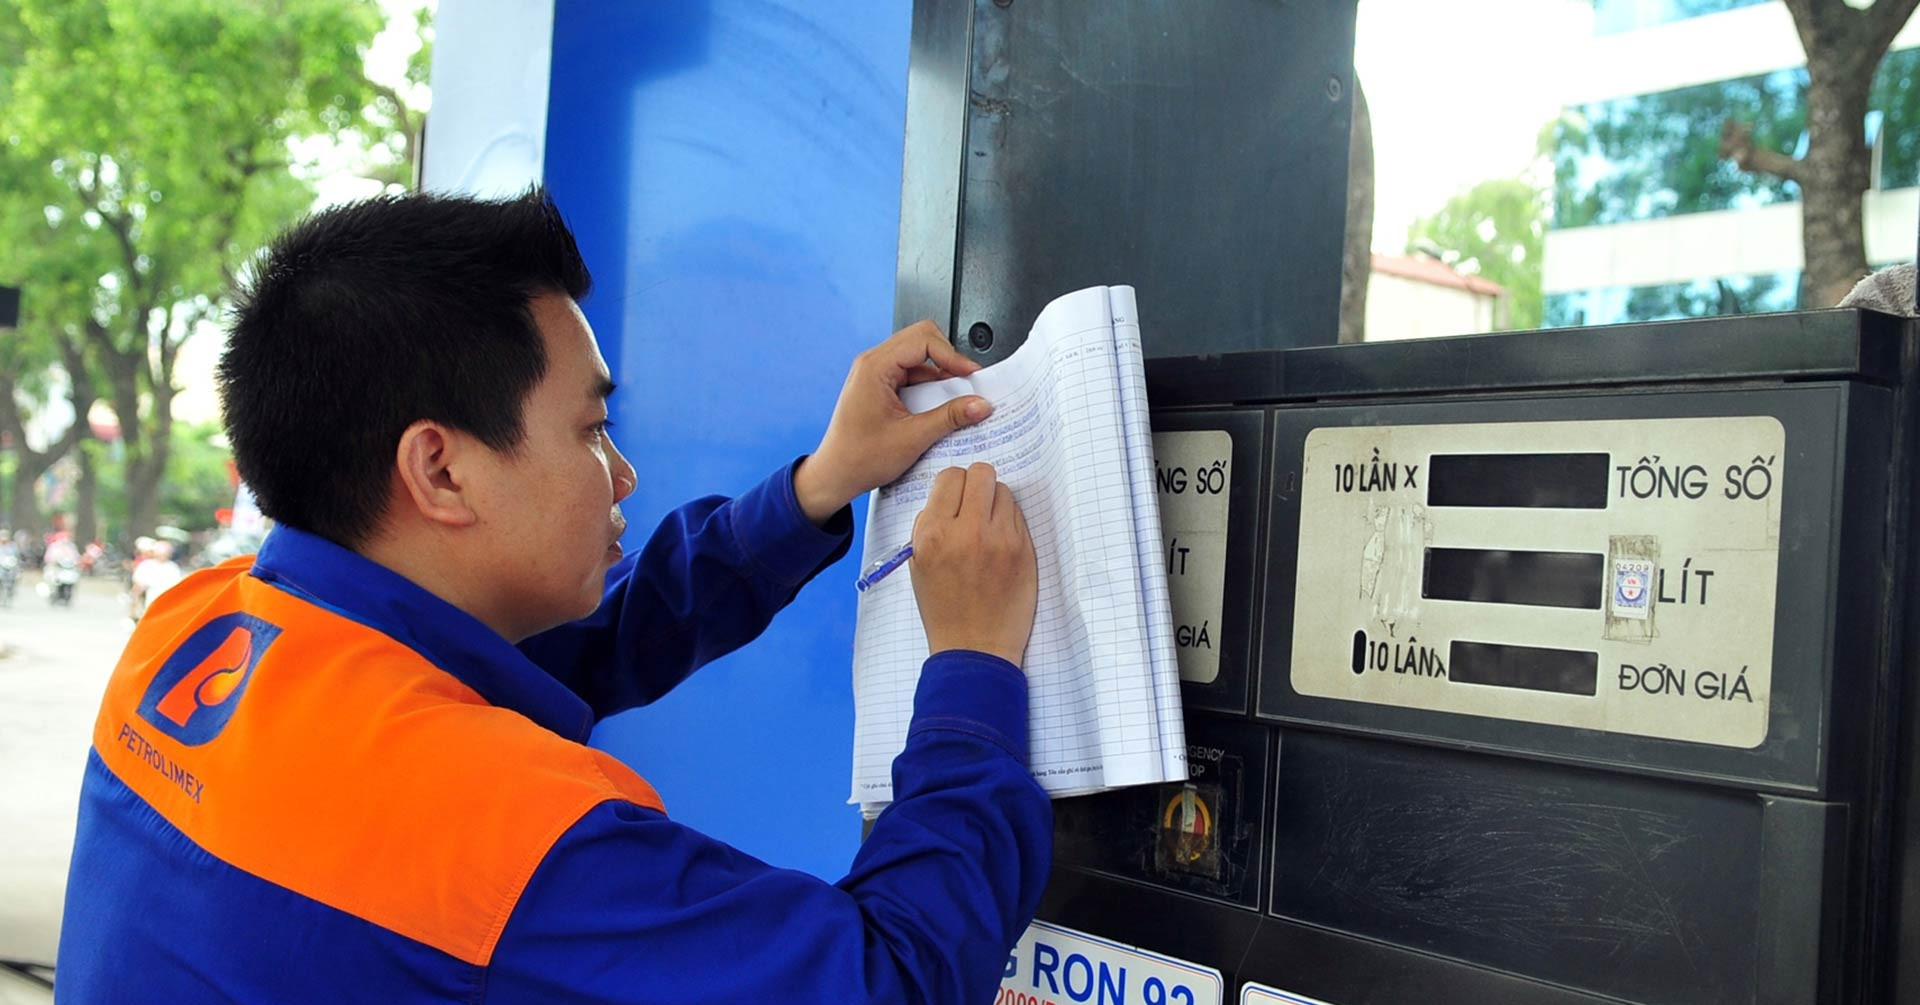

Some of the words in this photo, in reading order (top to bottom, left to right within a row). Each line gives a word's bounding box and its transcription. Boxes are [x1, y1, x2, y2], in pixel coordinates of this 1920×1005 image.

[1155, 460, 1187, 494] NG
[1196, 460, 1227, 494] SỐ
[1335, 463, 1354, 493] 10
[1359, 446, 1397, 492] LẦN
[1616, 455, 1709, 500] TỔNG
[1724, 455, 1775, 500] SỐ
[1169, 538, 1190, 576] ÍT
[1658, 557, 1714, 605] LÍT
[1176, 620, 1211, 649] GIÁ
[1369, 640, 1389, 672] 10
[1618, 664, 1686, 696] ĐƠN
[1694, 665, 1753, 703] GIÁ
[118, 722, 204, 804] PETROLIMEX
[1188, 744, 1225, 762] GENCY
[1189, 763, 1206, 777] OP
[1032, 941, 1127, 1005] RON
